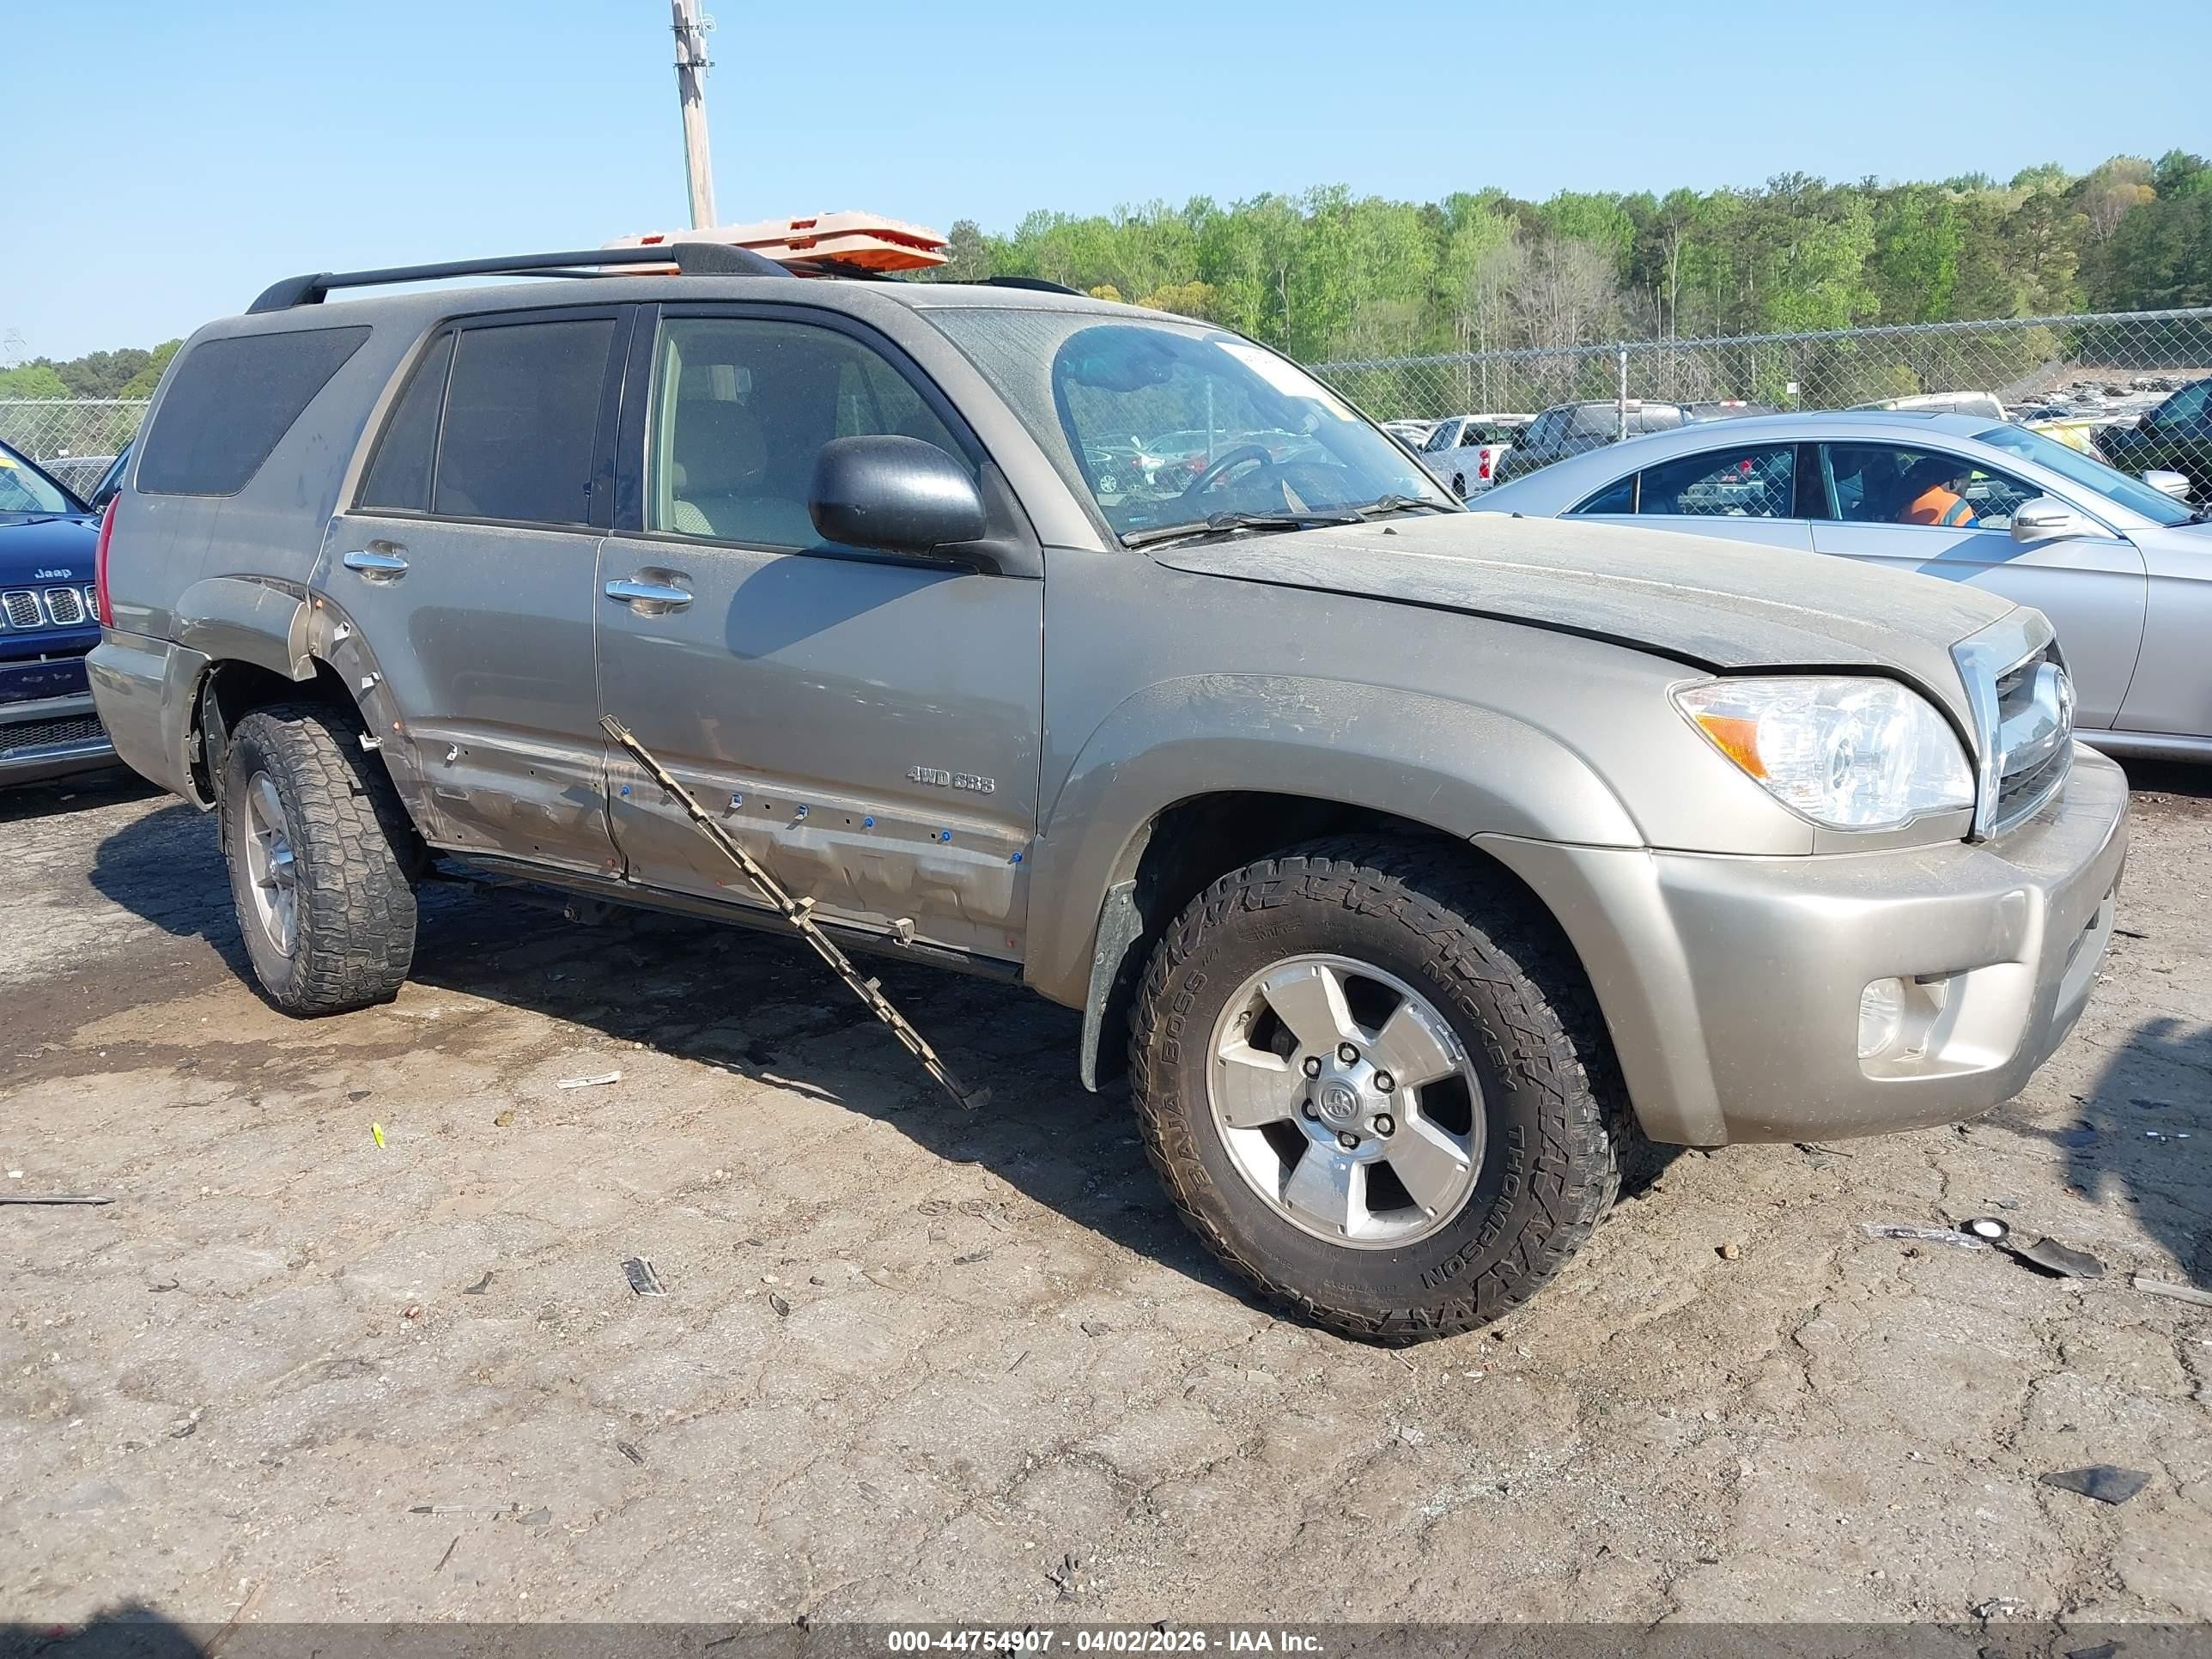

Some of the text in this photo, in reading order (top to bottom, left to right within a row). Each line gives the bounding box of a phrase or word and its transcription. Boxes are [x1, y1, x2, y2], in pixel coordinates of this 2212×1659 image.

[34, 568, 72, 579] Jeep
[907, 766, 995, 793] 4WD SR5
[1161, 969, 1213, 1191] BAJA BOSS
[1420, 959, 1525, 1289] MICKEY THOMPSON
